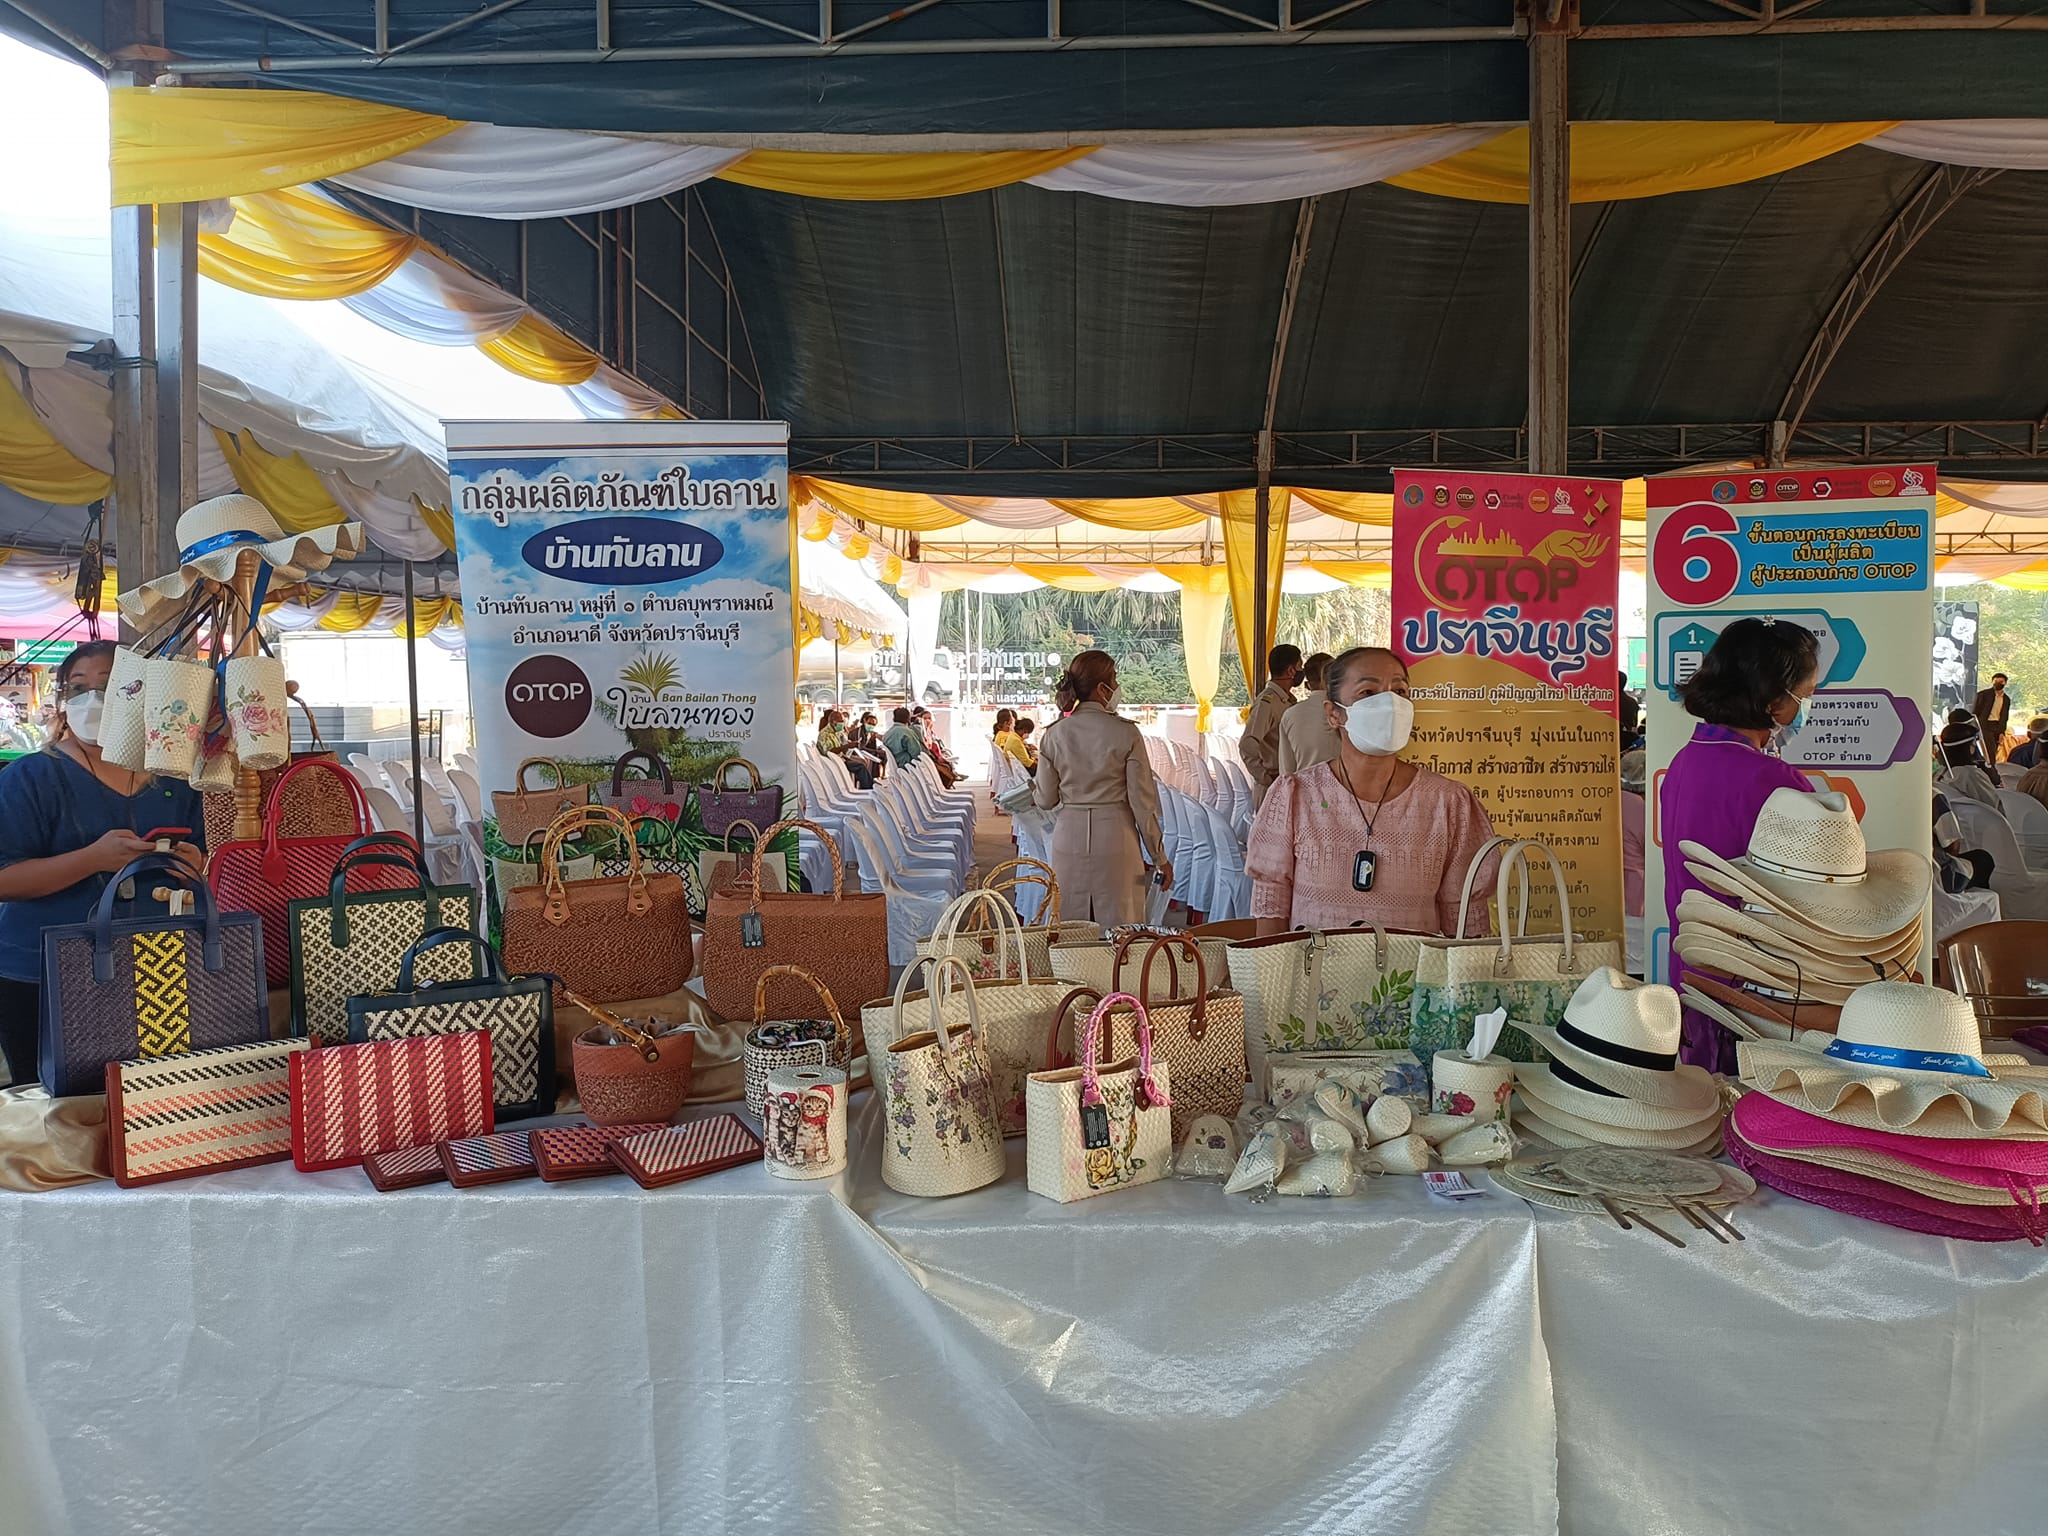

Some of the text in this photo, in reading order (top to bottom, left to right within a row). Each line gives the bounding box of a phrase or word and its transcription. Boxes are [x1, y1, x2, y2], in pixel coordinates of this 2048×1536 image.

[462, 466, 777, 524] กลุ่มผลิตภัณฑ์ใบลาน
[1748, 521, 1920, 544] ขั้นตอนการลงทะเบียน
[545, 536, 702, 569] บ้านทับลาน
[1653, 502, 1739, 607] 6
[1793, 543, 1873, 565] เป็นผู้ผลิต
[1435, 556, 1578, 602] OTOP
[1750, 564, 1916, 587] ผู้ประกอบการ OTOP
[476, 596, 573, 615] บ้านทับลาน
[580, 590, 617, 619] หมู่ที่
[643, 592, 774, 618] ตำบลบุพราหมณ์
[514, 623, 740, 648] อำเภอนาดี จังหวัดปราจีนบุรี
[1404, 605, 1613, 682] ปราจีนบุรี
[1688, 630, 1704, 645] 1.
[512, 683, 585, 702] OTOP
[631, 694, 650, 704] บ้าน
[662, 693, 757, 704] Ban Bailan Thong
[1409, 683, 1485, 700] กระดับโอทอป
[607, 687, 754, 726] ใบลานทอง
[1810, 700, 1879, 710] เภอตรวจสอบ
[1805, 715, 1870, 727] คำขอร่วมกับ
[708, 729, 752, 740] ปราจีนบุรี
[1531, 725, 1614, 747] มุ่งเน้นในการ
[1814, 733, 1861, 744] เครือข่าย
[1477, 754, 1544, 774] สร้างอาชีพ
[1550, 753, 1615, 774] สร้างรายได้
[1803, 750, 1872, 761] OTOP อำเภอ
[1497, 785, 1574, 803] ผู้ประกอบการ
[1581, 786, 1614, 799] OTOP
[1487, 807, 1602, 827] ยนรู้พัฒนาผลิตภัณฑ์
[1570, 906, 1596, 918] TOP
